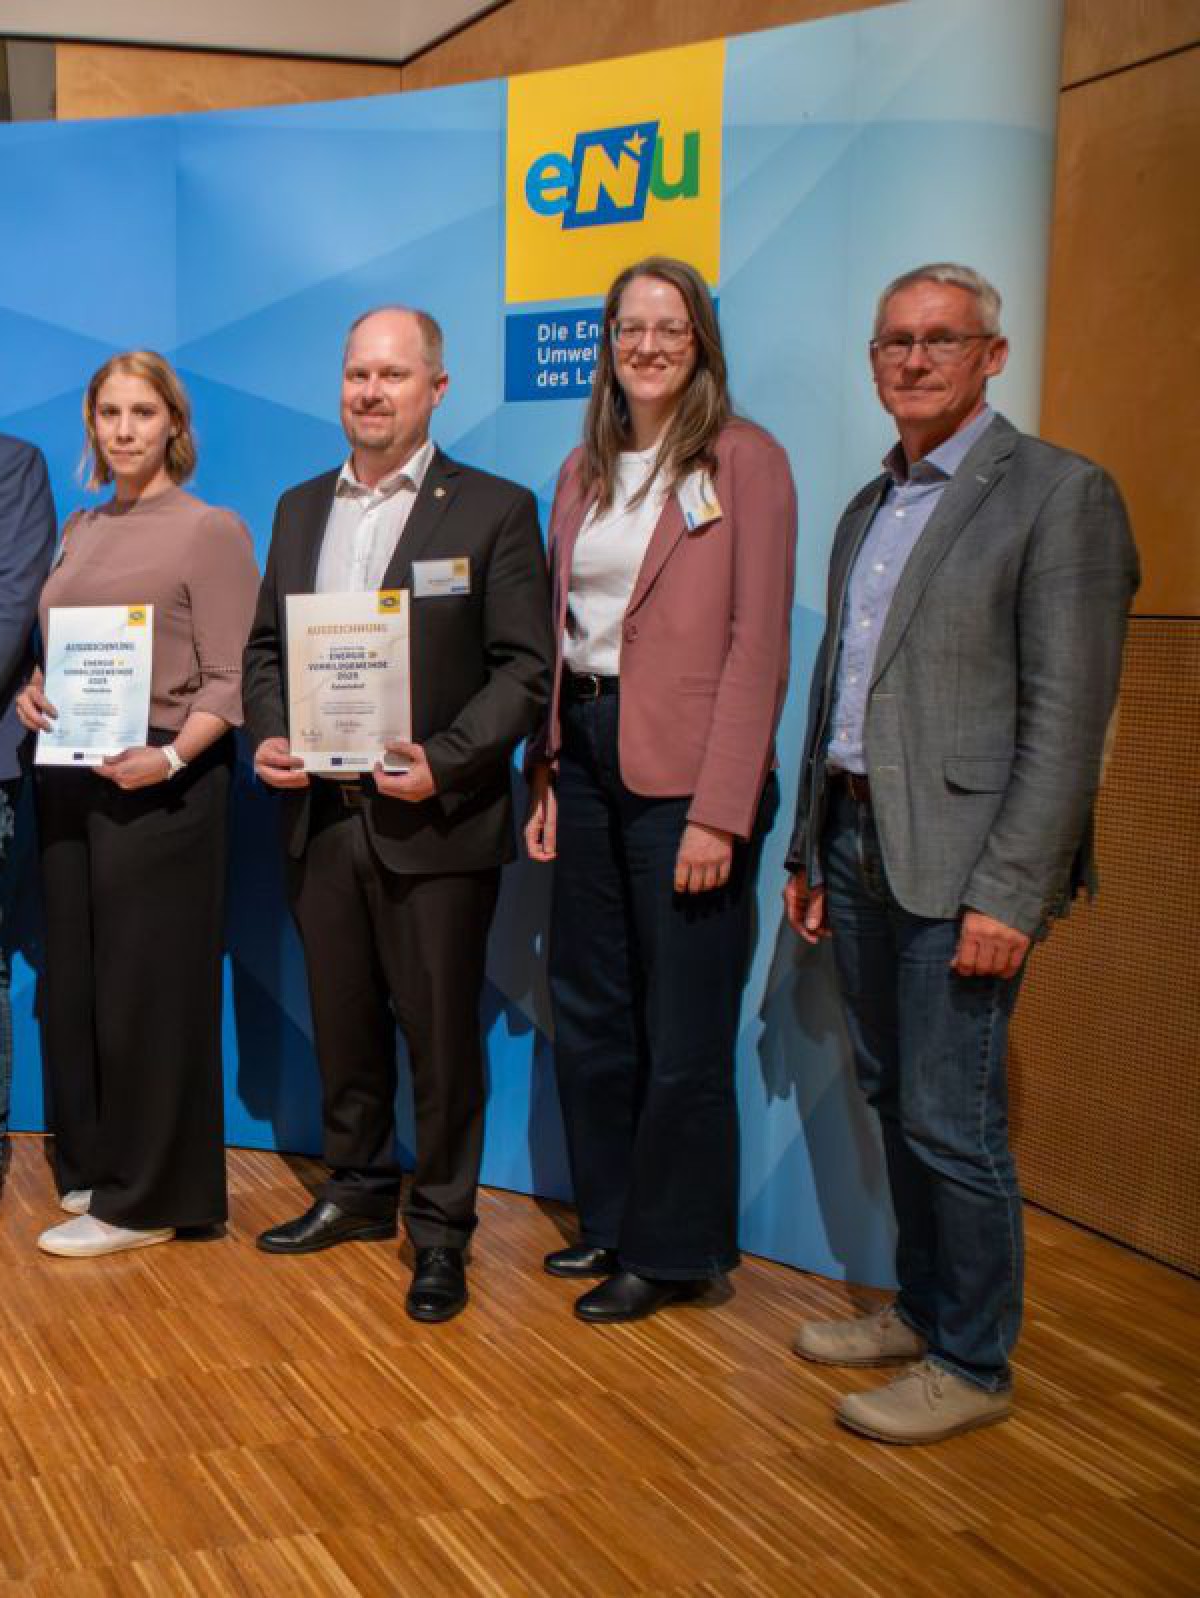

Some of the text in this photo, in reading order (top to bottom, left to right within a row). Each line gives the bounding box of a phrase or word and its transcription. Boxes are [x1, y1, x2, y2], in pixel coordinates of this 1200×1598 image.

[537, 319, 602, 342] Die En
[537, 369, 569, 387] des
[307, 624, 388, 635] AUSZEICHNUNG
